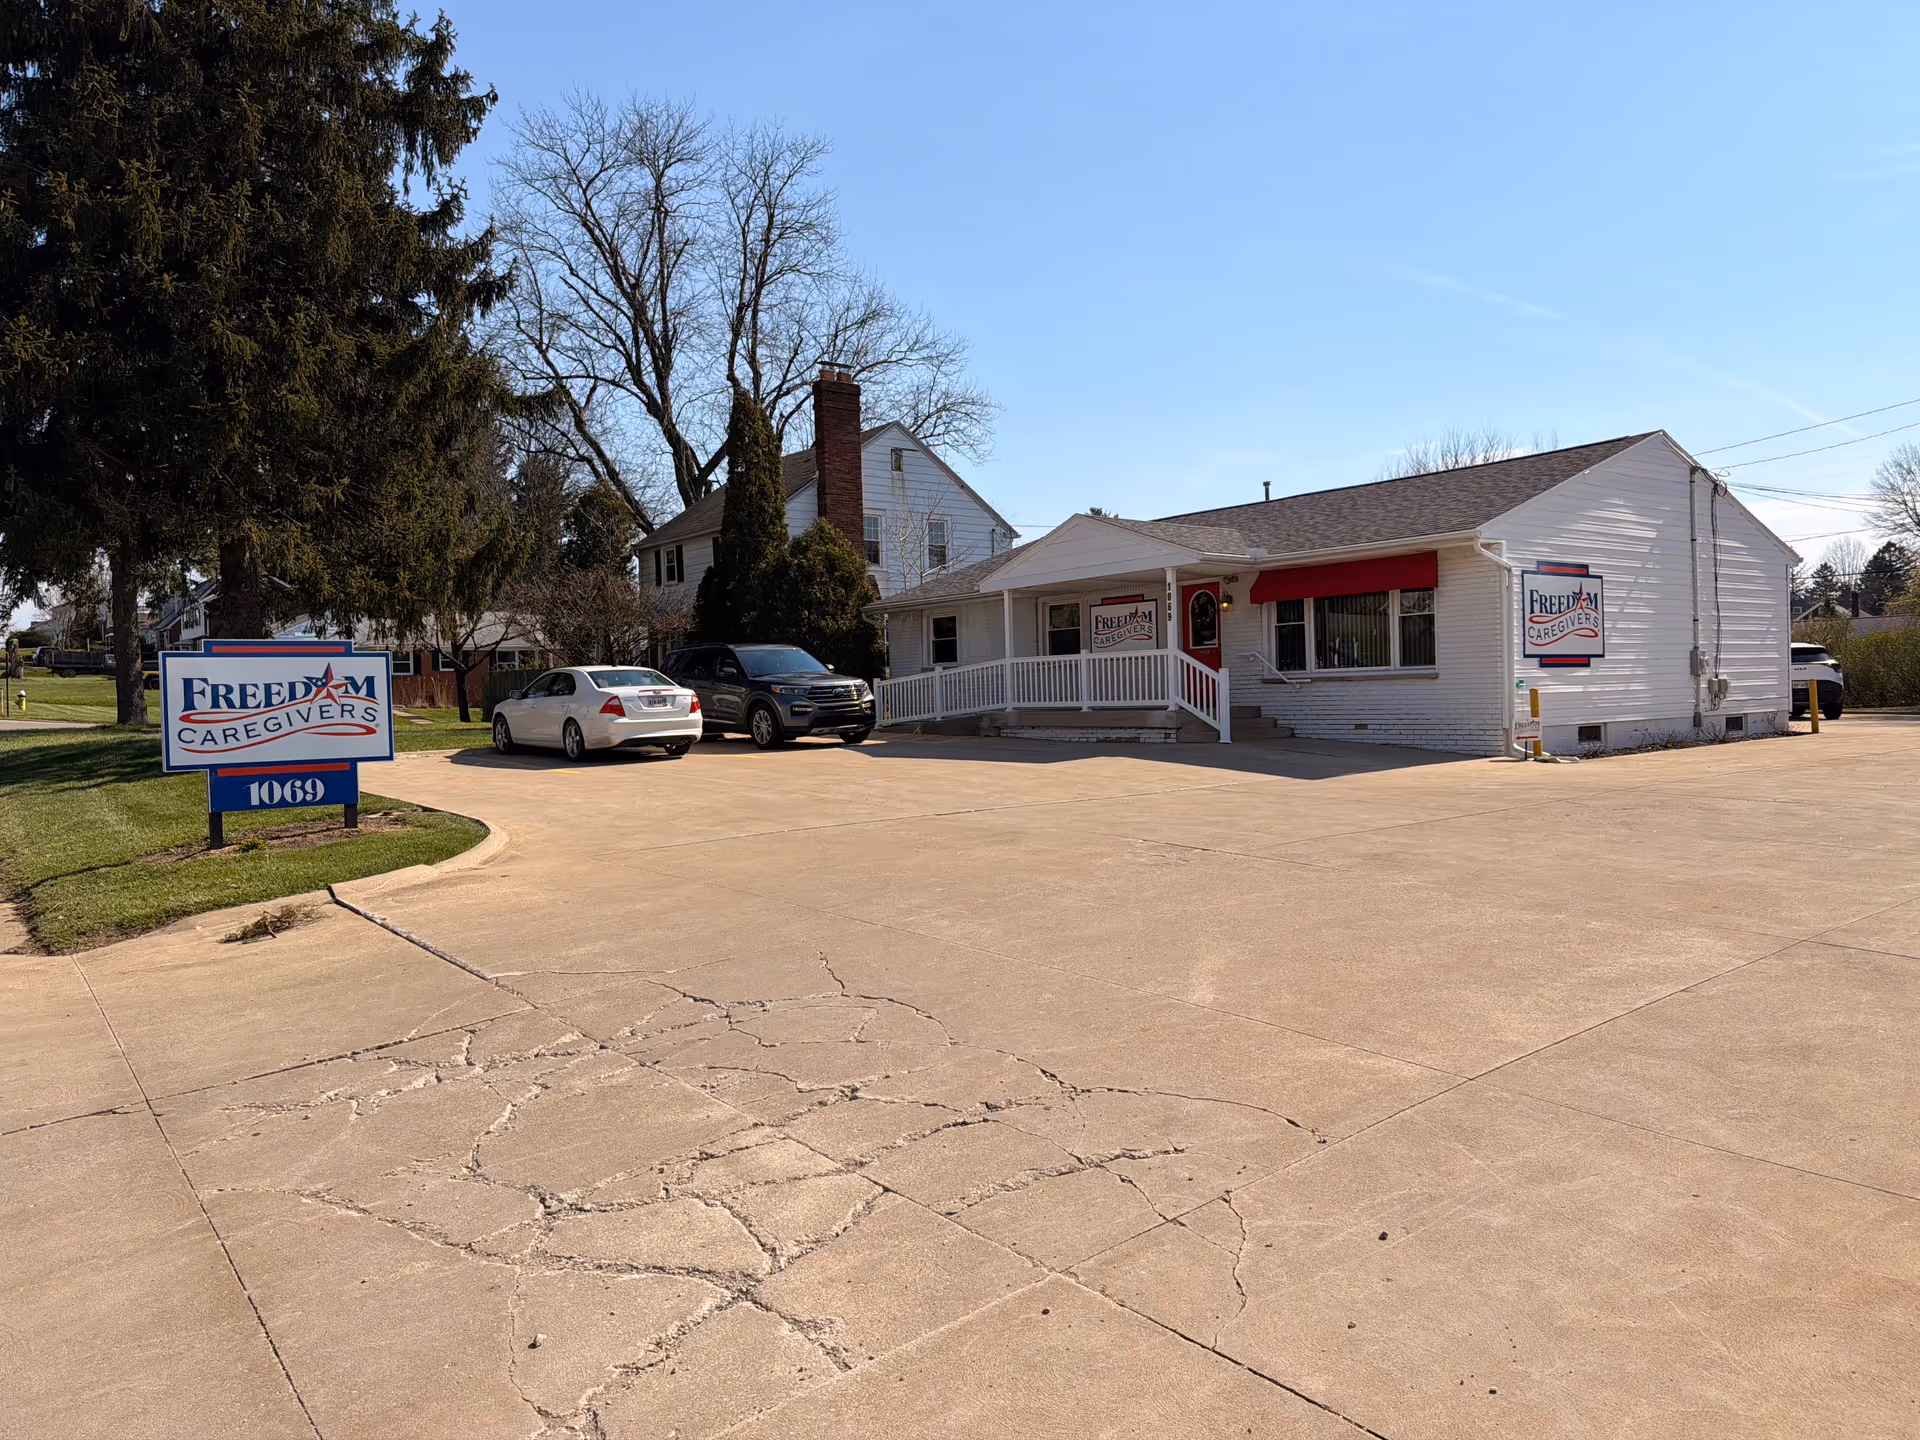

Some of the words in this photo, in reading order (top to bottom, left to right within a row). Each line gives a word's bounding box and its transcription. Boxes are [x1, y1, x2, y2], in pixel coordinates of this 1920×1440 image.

[1529, 582, 1599, 614] FREEDM
[1095, 606, 1153, 630] FREEDM
[1528, 612, 1599, 640] CAREGIVERS
[1094, 624, 1153, 645] CAREGIVERS
[181, 663, 378, 712] FREEDM
[177, 703, 378, 746] CAREGIVERS
[245, 778, 325, 805] 1069
